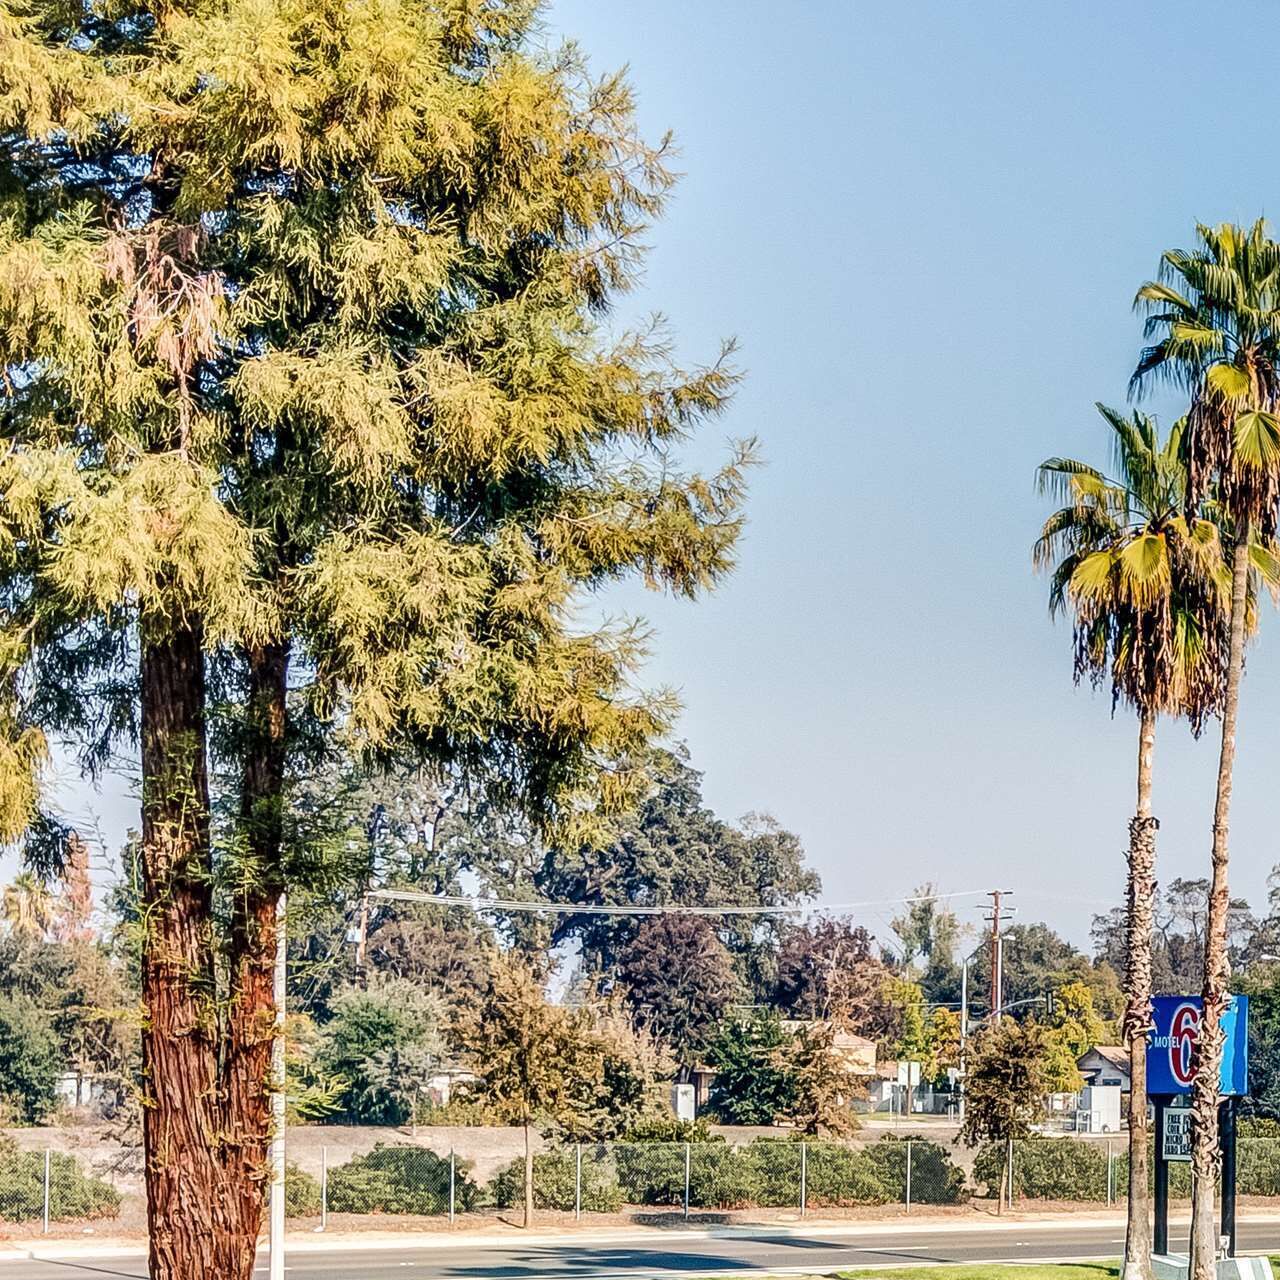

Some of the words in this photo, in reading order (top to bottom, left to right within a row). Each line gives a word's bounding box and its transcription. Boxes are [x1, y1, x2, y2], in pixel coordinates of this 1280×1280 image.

[1154, 1036, 1181, 1049] MOTEL
[1168, 1003, 1201, 1087] 6
[1168, 1114, 1181, 1125] FREE
